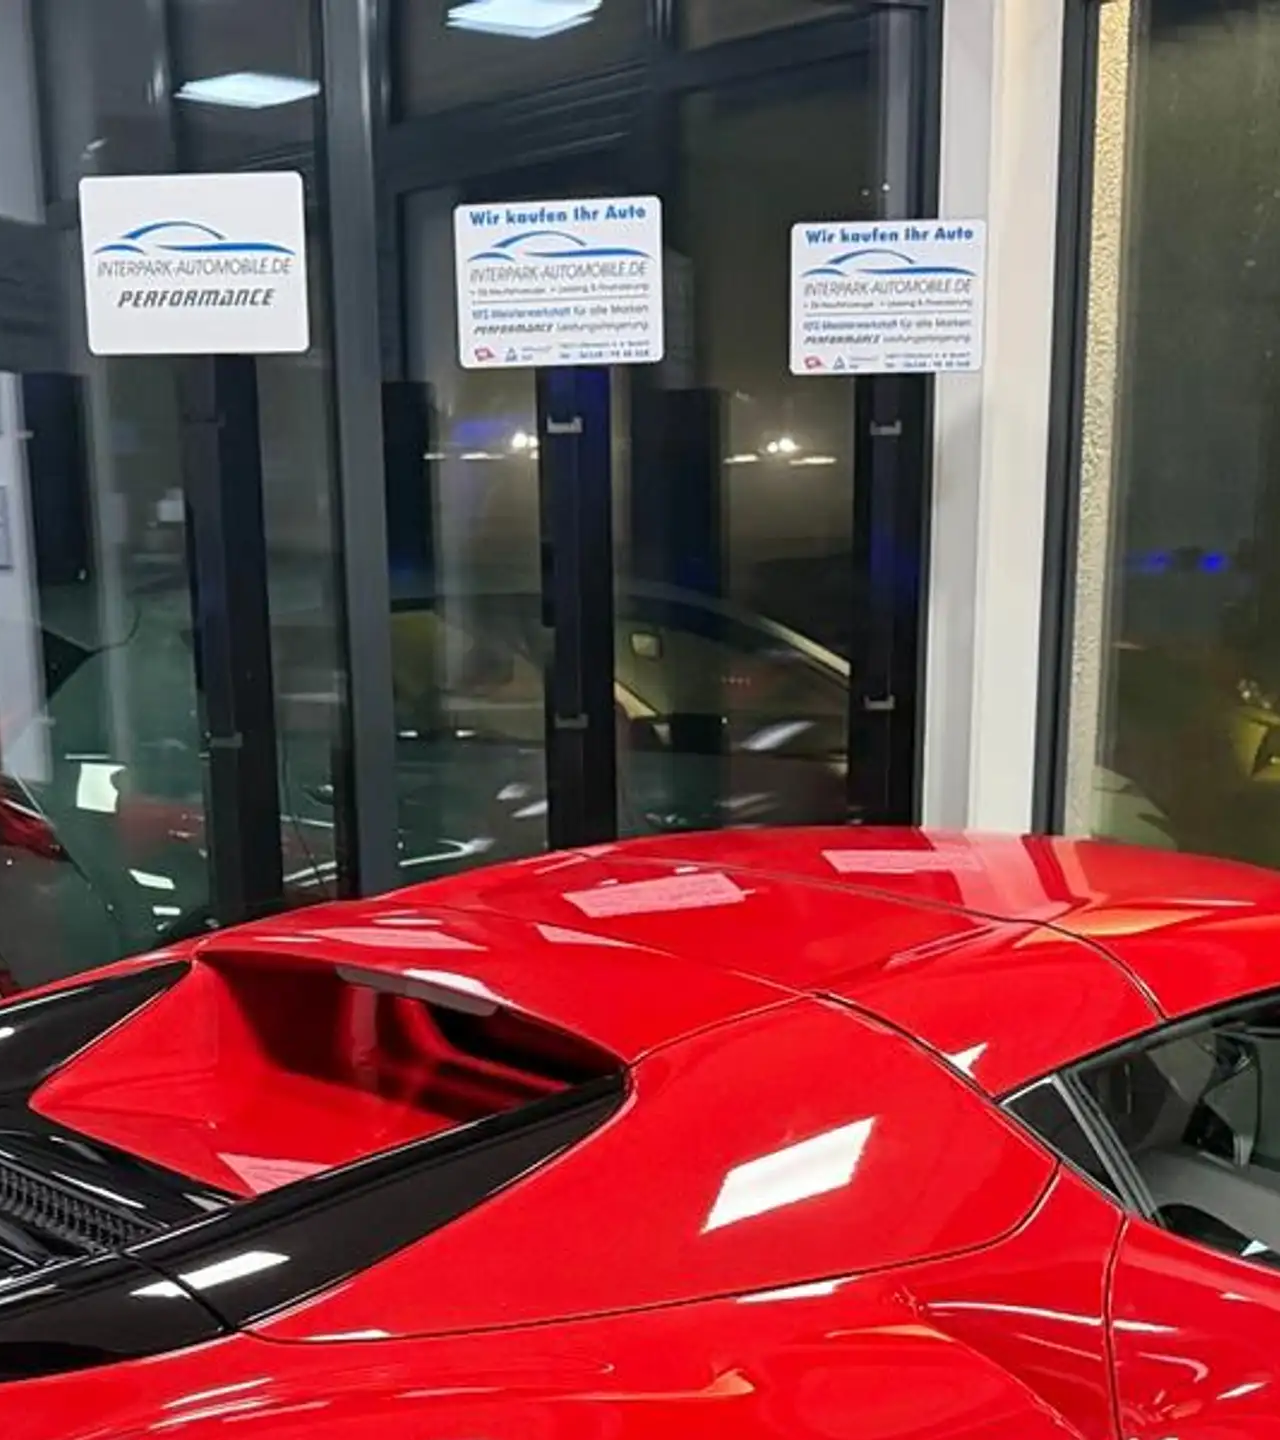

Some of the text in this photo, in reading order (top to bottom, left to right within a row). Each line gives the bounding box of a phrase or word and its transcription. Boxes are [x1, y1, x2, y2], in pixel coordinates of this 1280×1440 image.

[470, 204, 646, 226] Wir kaufen Ihr Auto
[806, 225, 974, 244] Wir kaufen Ihr Auto
[97, 257, 293, 277] INTERPARK-AUTOMOBILE.DE
